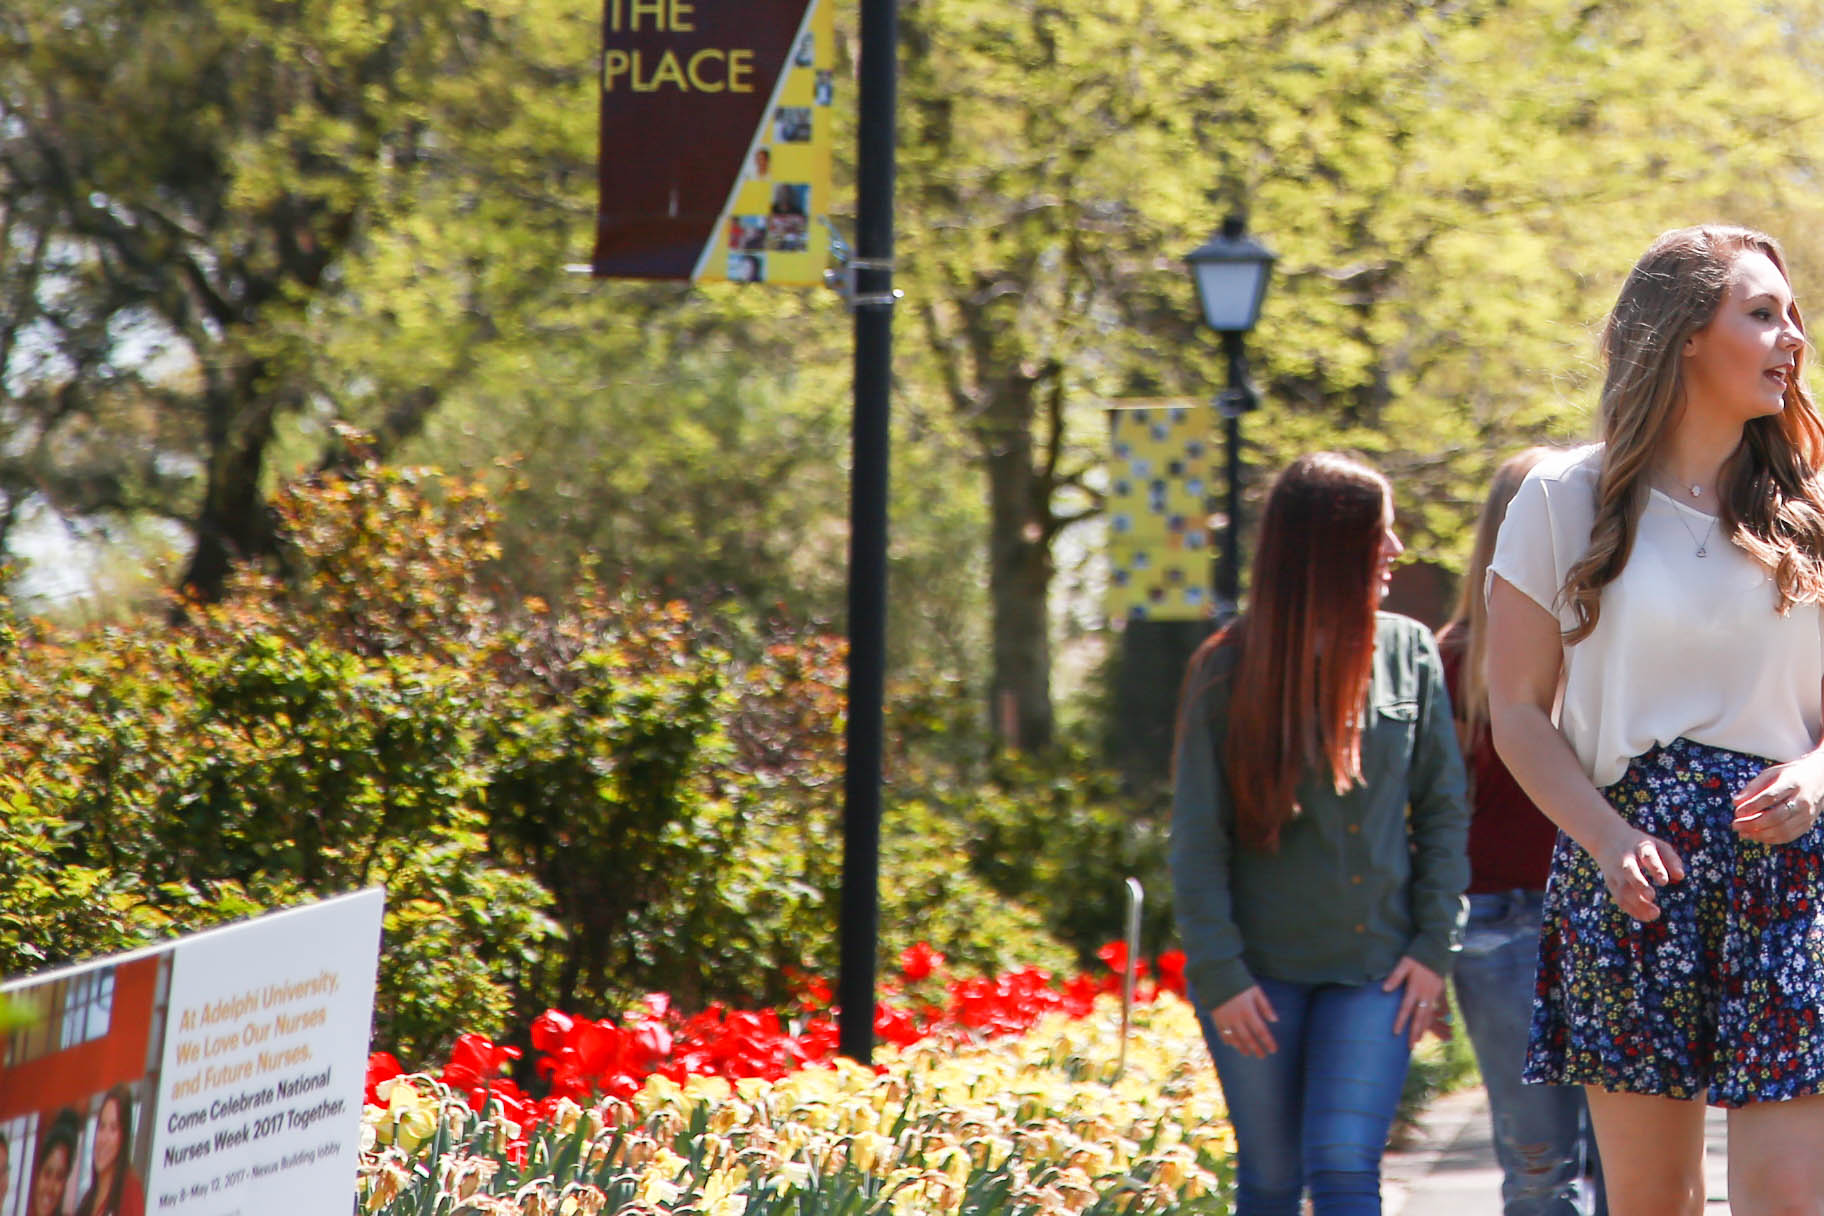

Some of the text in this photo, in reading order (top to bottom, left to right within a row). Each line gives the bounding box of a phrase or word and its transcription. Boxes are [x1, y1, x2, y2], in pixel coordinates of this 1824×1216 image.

[604, 48, 755, 93] PLACE
[176, 1007, 328, 1067] We Love Our Nurses
[179, 1008, 197, 1033] At
[200, 990, 259, 1027] Adelphi
[167, 1065, 332, 1134] Come Celebrate National
[171, 1043, 313, 1101] and Future Nurses.
[163, 1098, 346, 1169] Nurses Week 2017 Together.
[158, 1194, 178, 1209] May
[191, 1184, 209, 1199] May
[280, 1150, 315, 1170] Building
